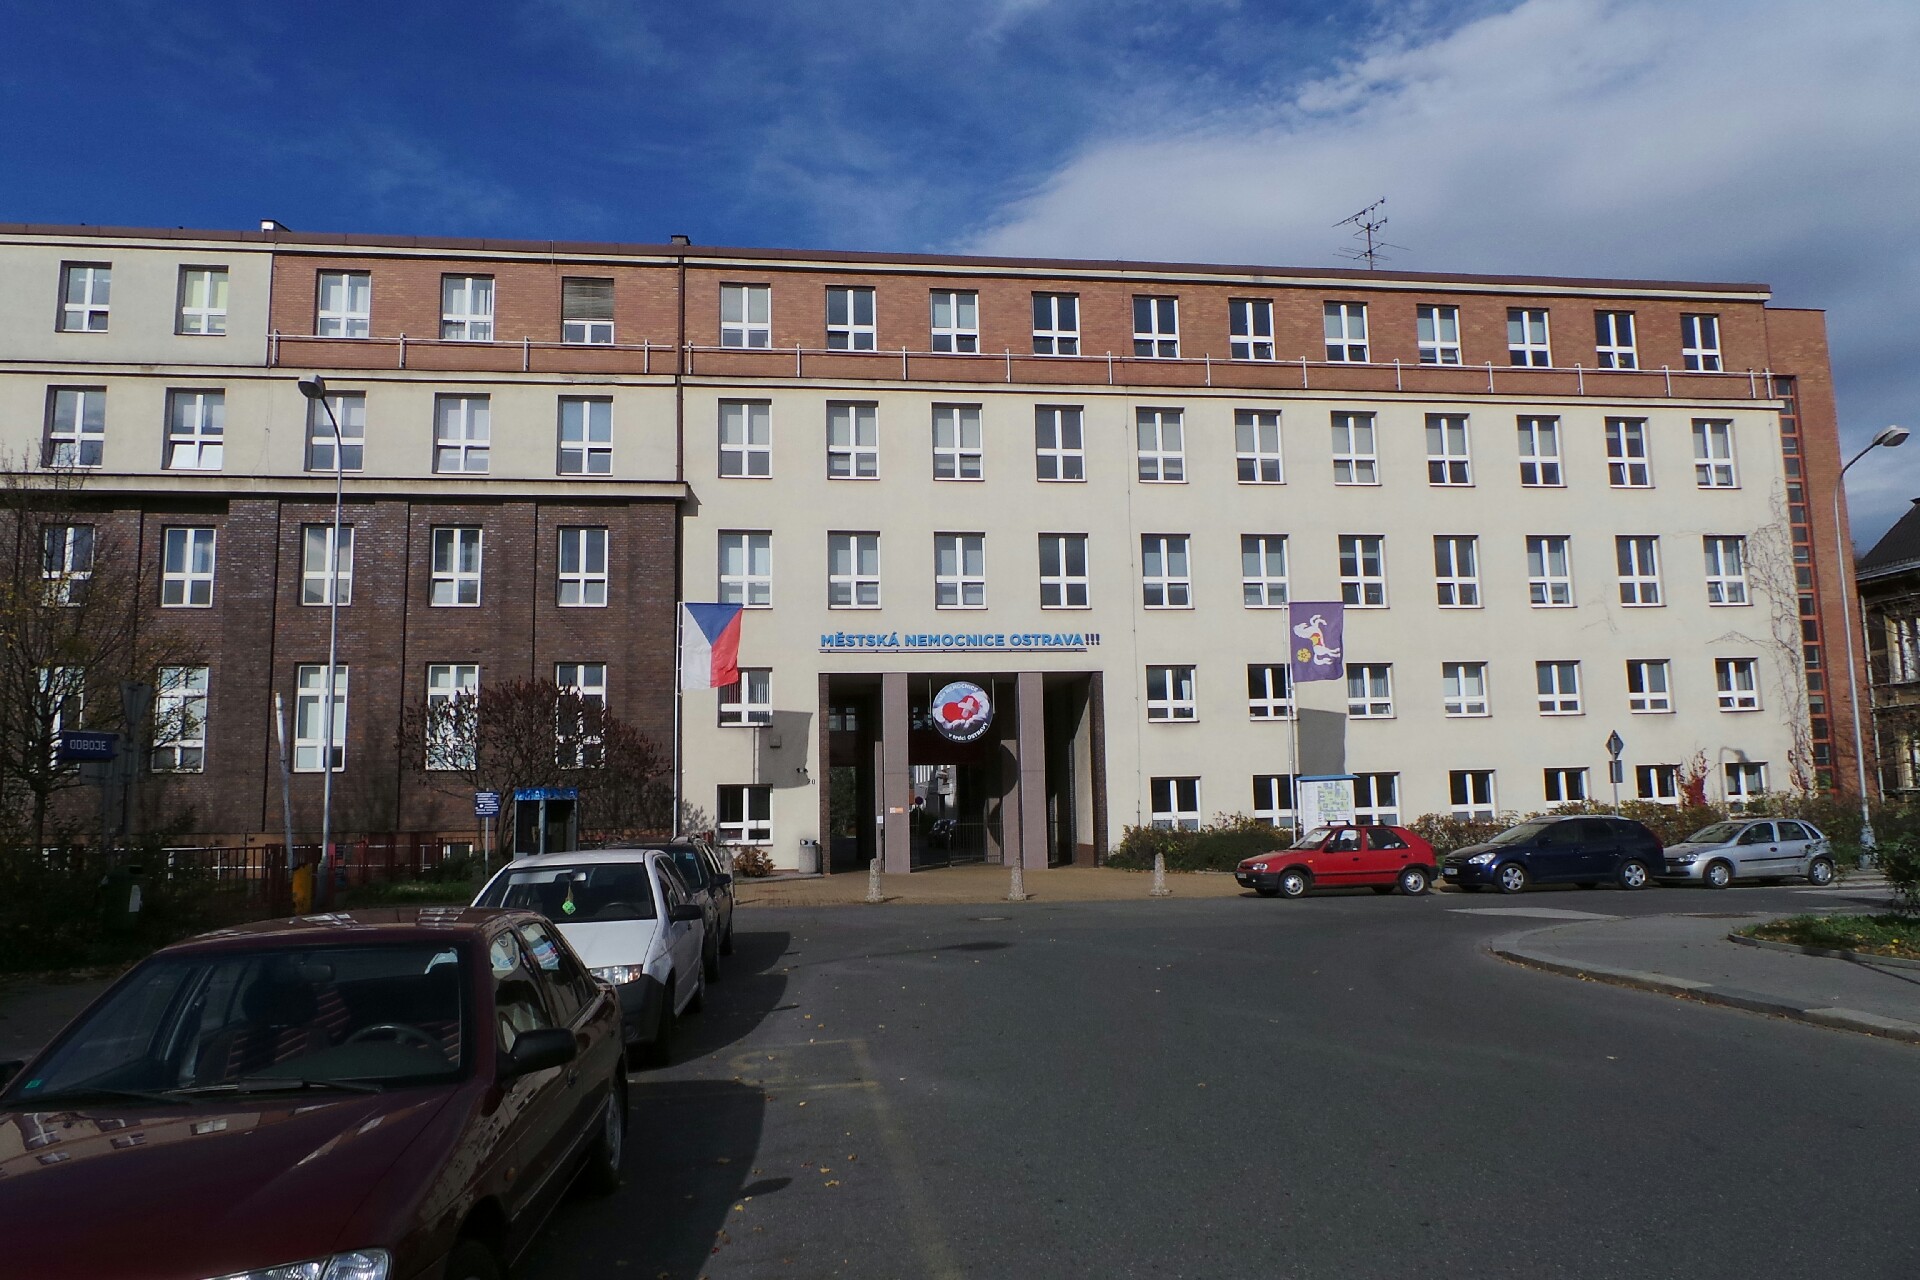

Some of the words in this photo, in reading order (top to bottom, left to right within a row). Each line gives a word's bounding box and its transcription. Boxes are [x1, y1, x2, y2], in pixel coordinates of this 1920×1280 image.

[821, 631, 900, 647] MĚSTSKÁ
[904, 634, 1005, 647] NEMOCNICE
[967, 721, 988, 740] OSTRAVY
[70, 740, 107, 750] ODBOJE
